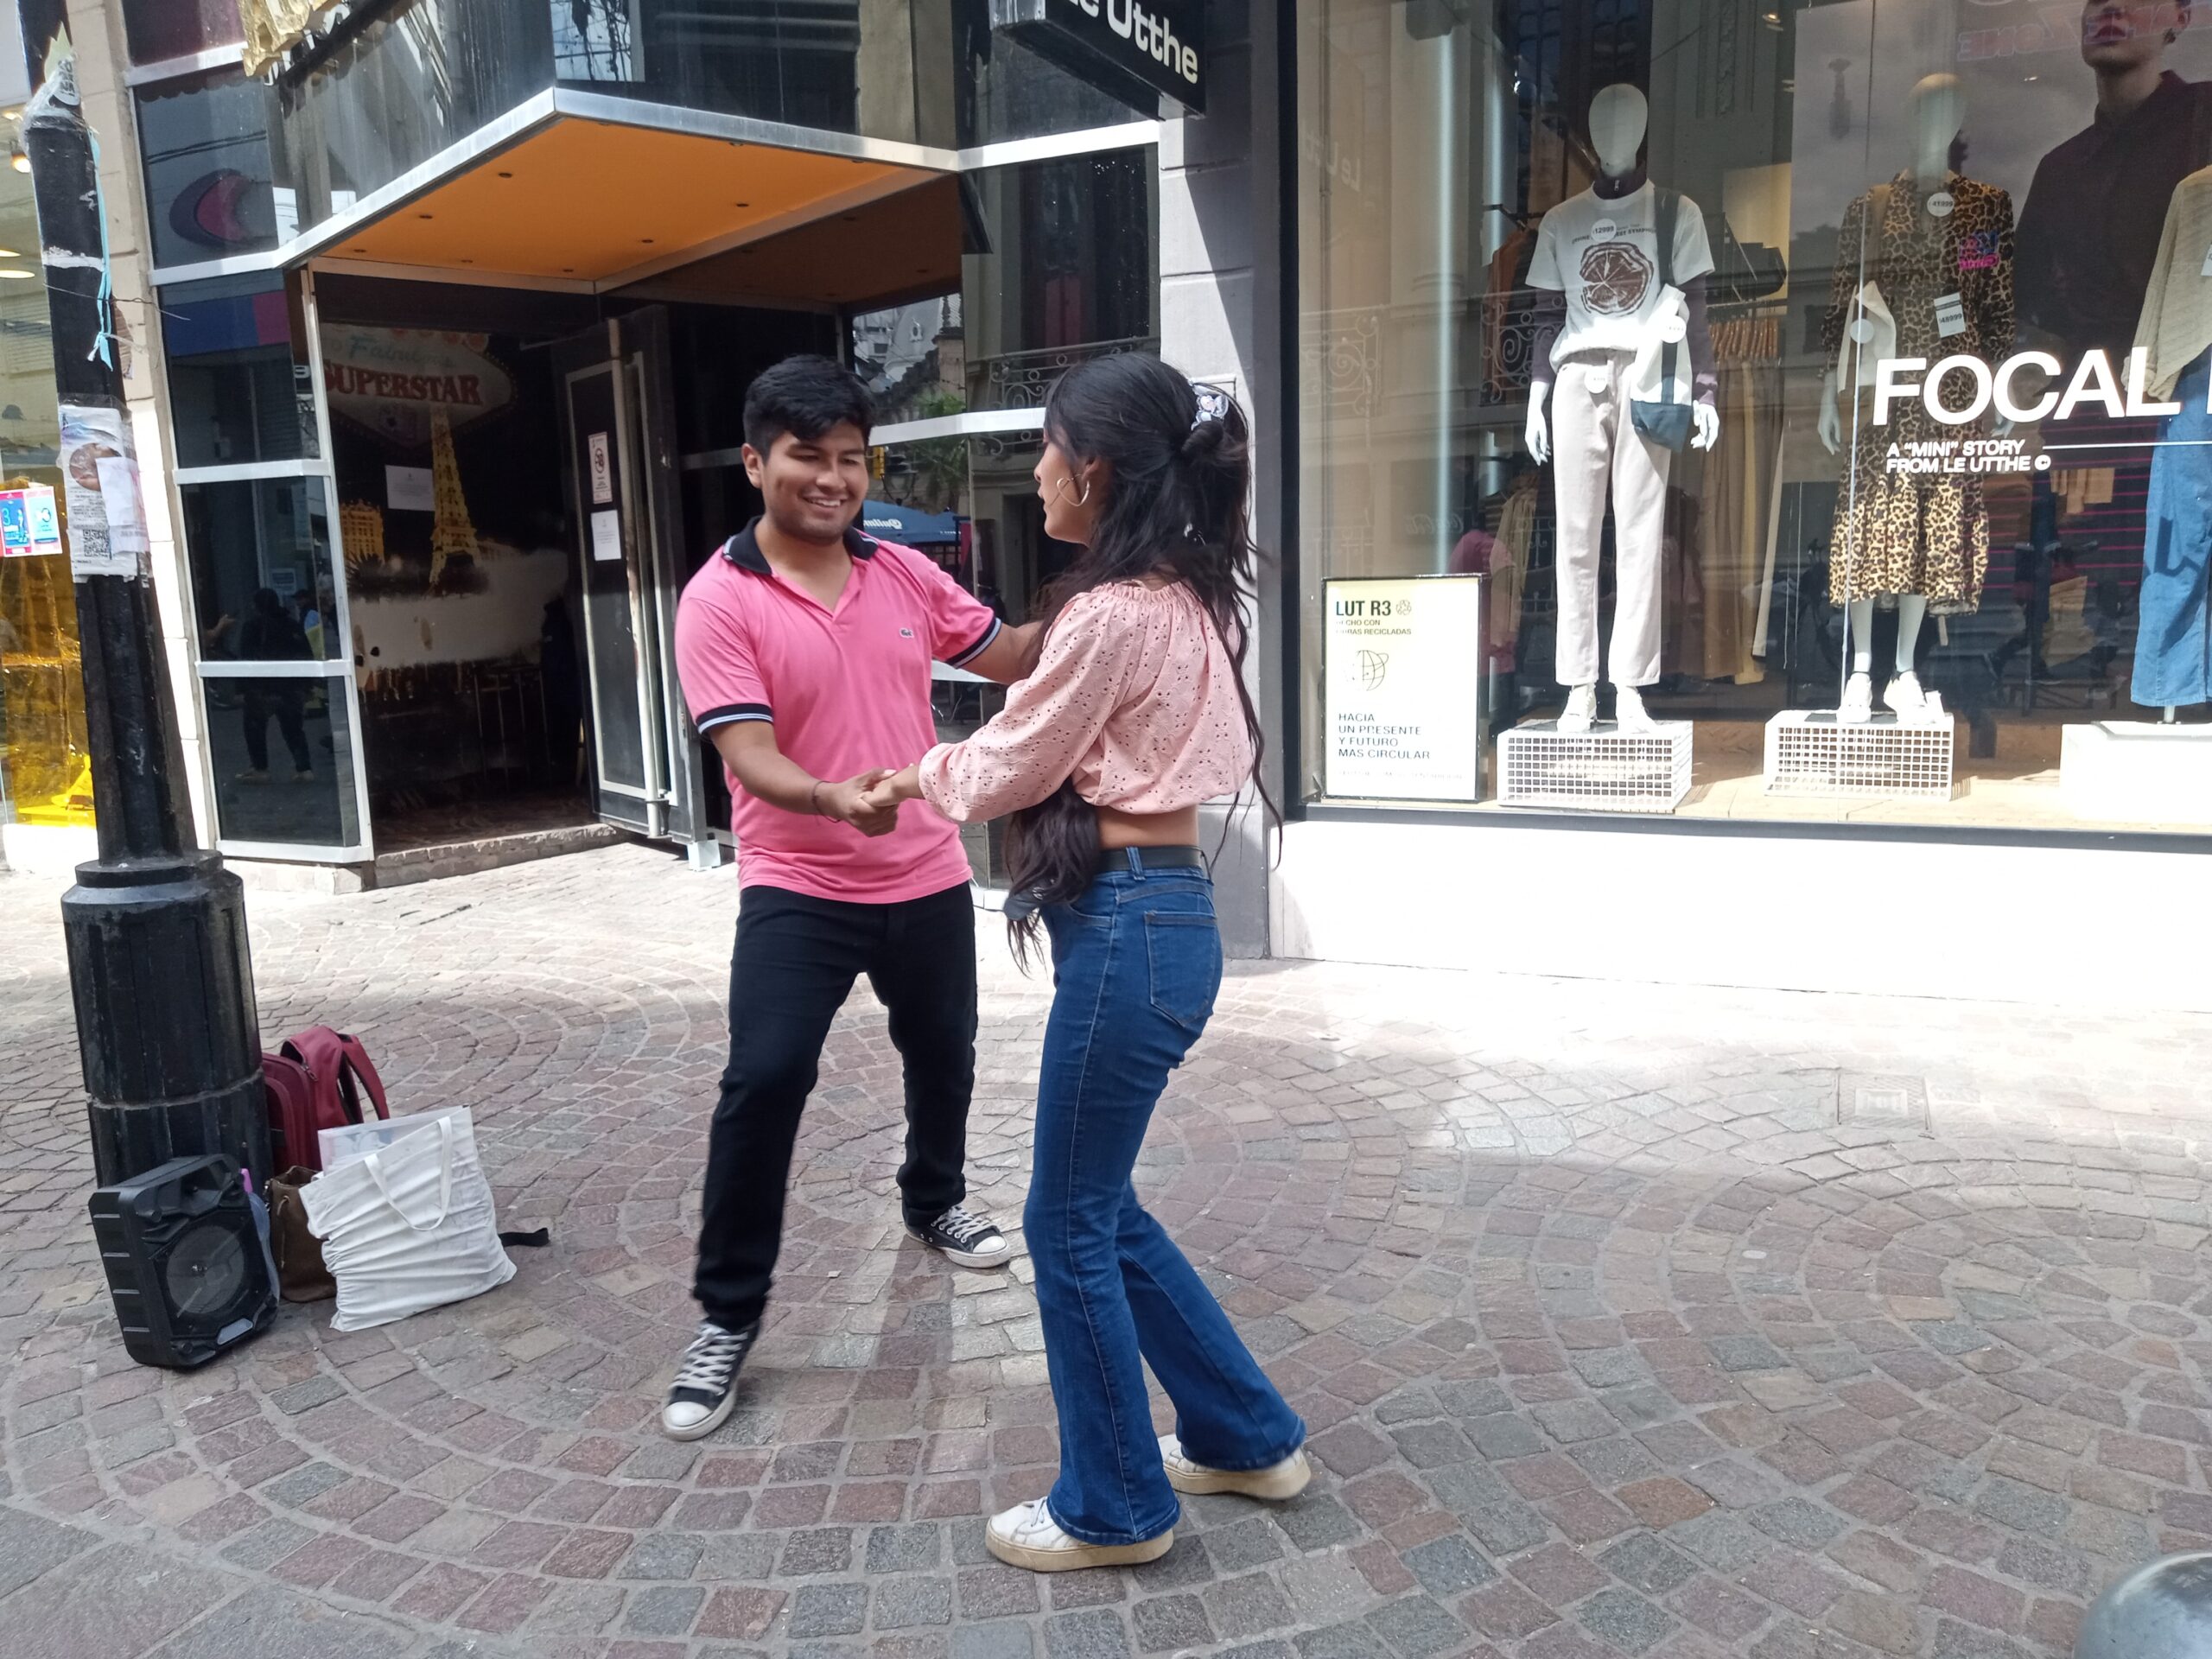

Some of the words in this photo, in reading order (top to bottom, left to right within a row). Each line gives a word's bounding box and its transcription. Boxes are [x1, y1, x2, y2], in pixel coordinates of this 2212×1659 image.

[323, 359, 484, 406] SUPERSTAR
[1872, 346, 2182, 426] FOCAL
[1886, 442, 1900, 457] A
[1962, 439, 2025, 456] STORY
[1886, 457, 1939, 474] FROM
[1942, 456, 1966, 473] LE
[1969, 455, 2031, 473] UTTHE
[1336, 601, 1365, 616] LUT
[1371, 601, 1391, 616] R3
[1338, 713, 1375, 722] HACIA
[1338, 725, 1355, 734] UN
[1359, 725, 1421, 735] PRESENTE
[1338, 737, 1346, 746] Y
[1350, 737, 1399, 747] FUTURO
[1338, 748, 1364, 758] MAS
[1368, 749, 1430, 760] CIRCULAR
